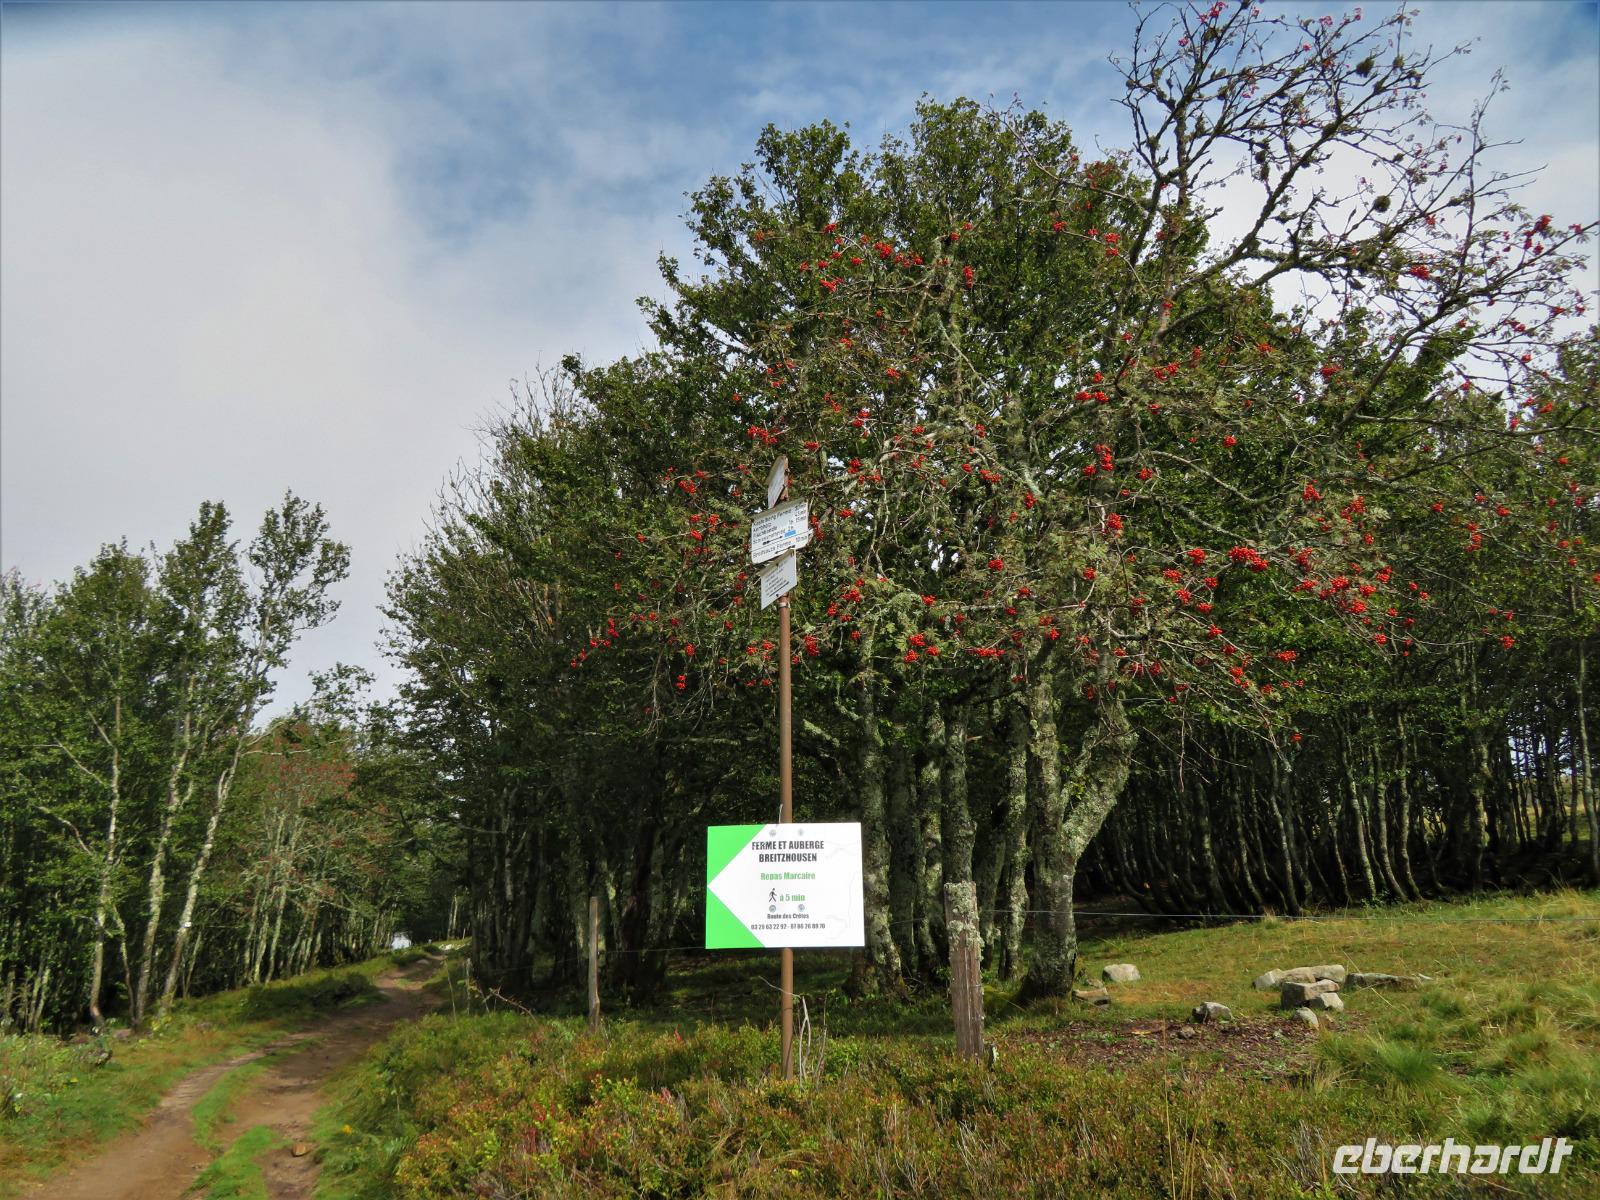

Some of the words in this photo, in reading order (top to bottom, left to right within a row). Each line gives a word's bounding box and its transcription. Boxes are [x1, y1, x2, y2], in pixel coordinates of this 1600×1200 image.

[752, 841, 777, 850] FERME
[778, 841, 787, 850] ET
[788, 841, 824, 850] AUBERGE
[759, 853, 817, 862] BREITZHOUSEN
[760, 873, 782, 881] Repas
[784, 872, 815, 880] Marcaire
[785, 894, 790, 902] 5
[791, 894, 805, 902] min
